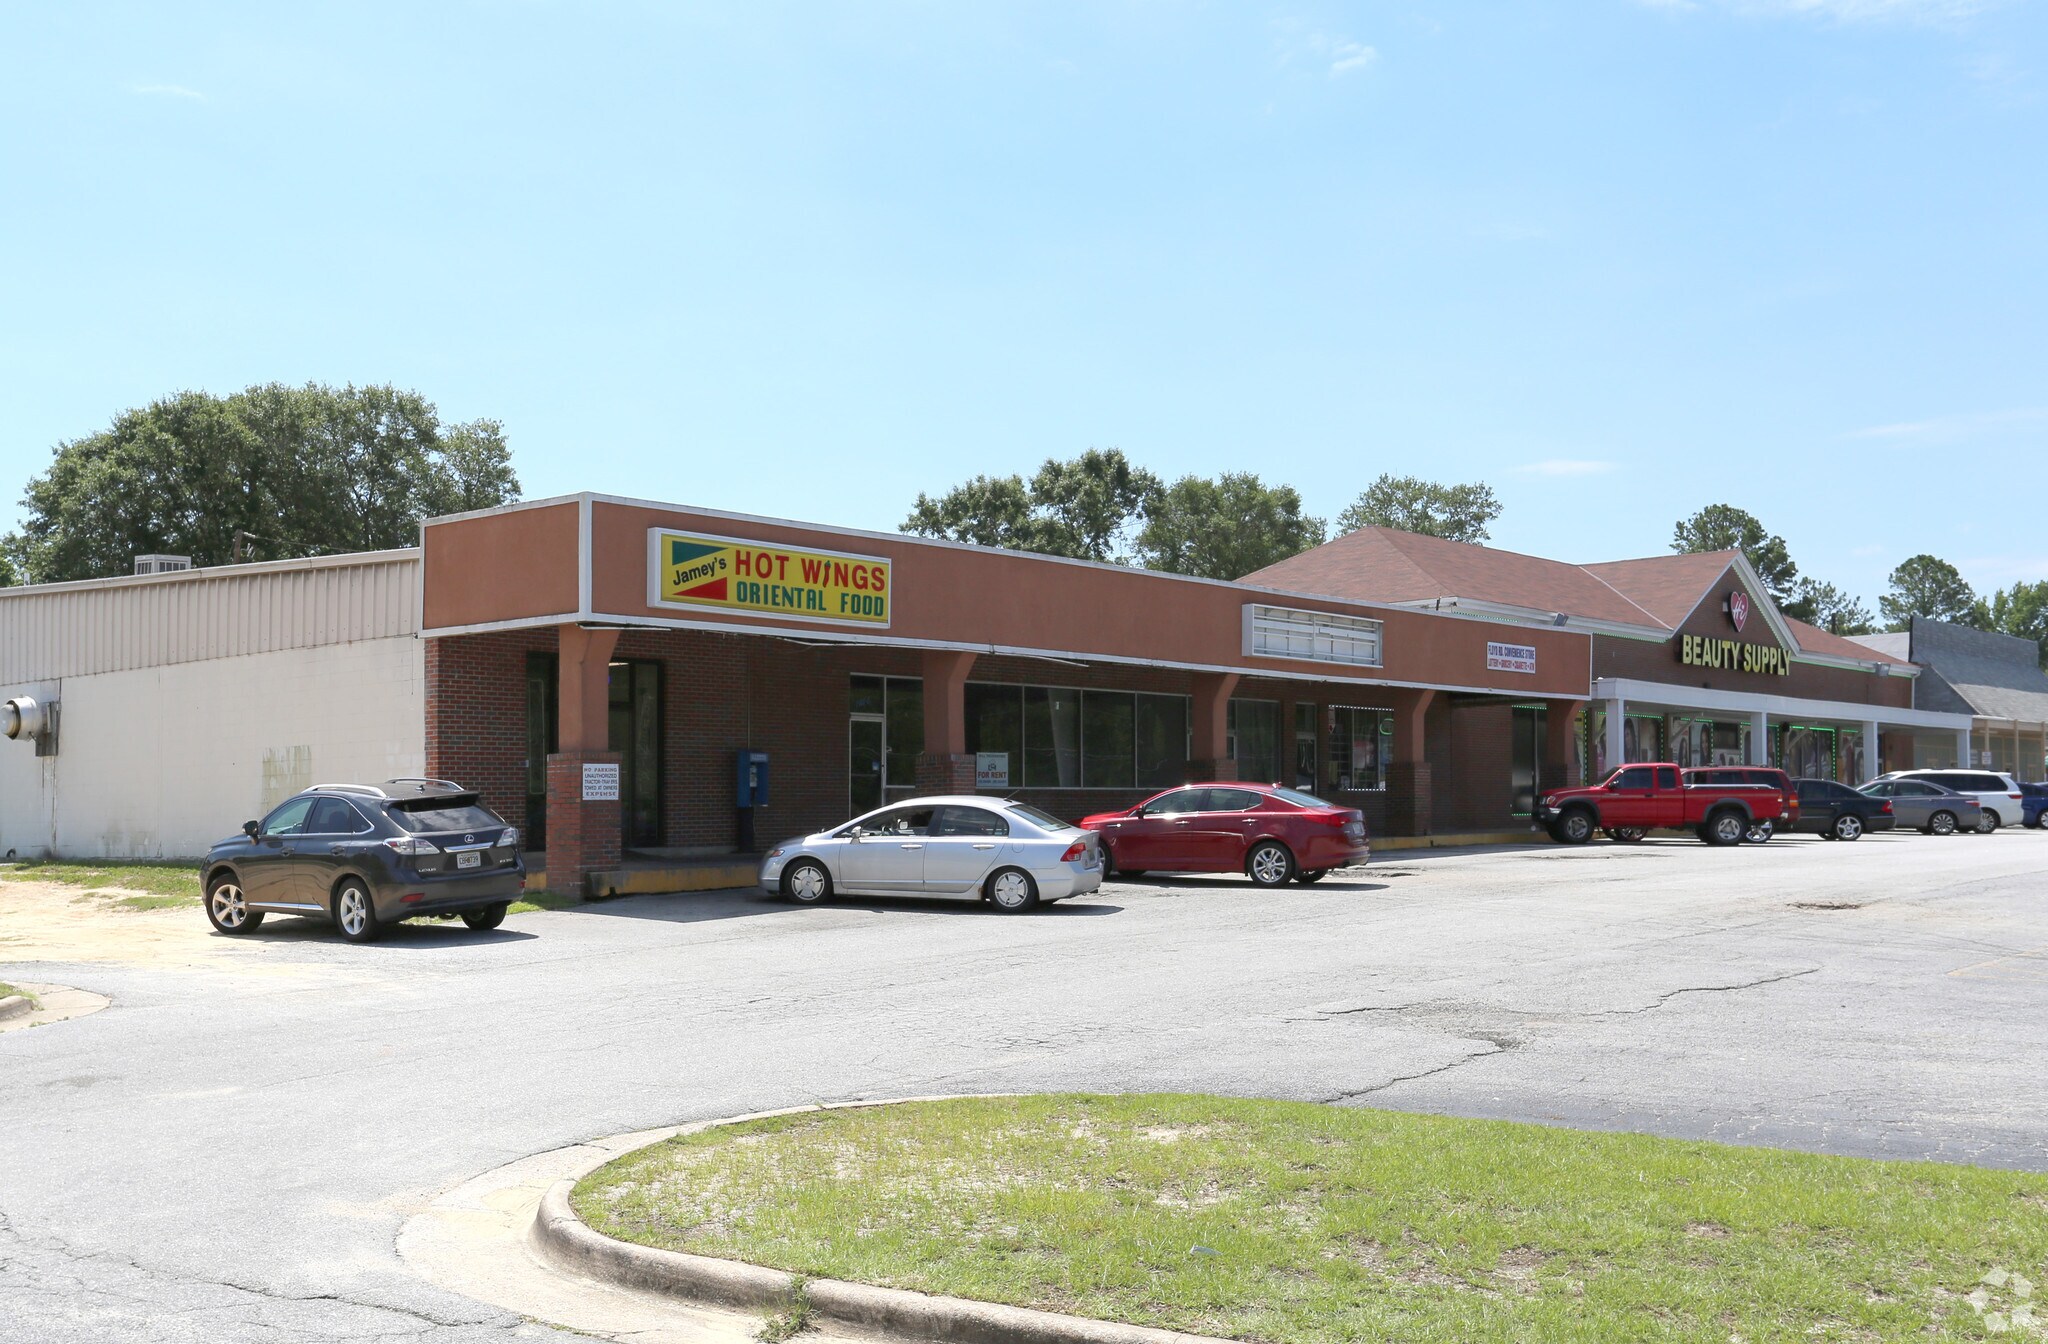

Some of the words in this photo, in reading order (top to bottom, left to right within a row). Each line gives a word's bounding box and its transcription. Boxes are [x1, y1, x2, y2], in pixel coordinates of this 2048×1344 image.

[673, 557, 727, 586] Jamey's
[736, 550, 789, 581] HOT
[801, 558, 885, 592] WINGS
[736, 581, 827, 611] ORIENTAL
[840, 592, 884, 617] FOOD
[1682, 634, 1740, 670] BEAUTY
[1743, 643, 1792, 676] SUPPLY
